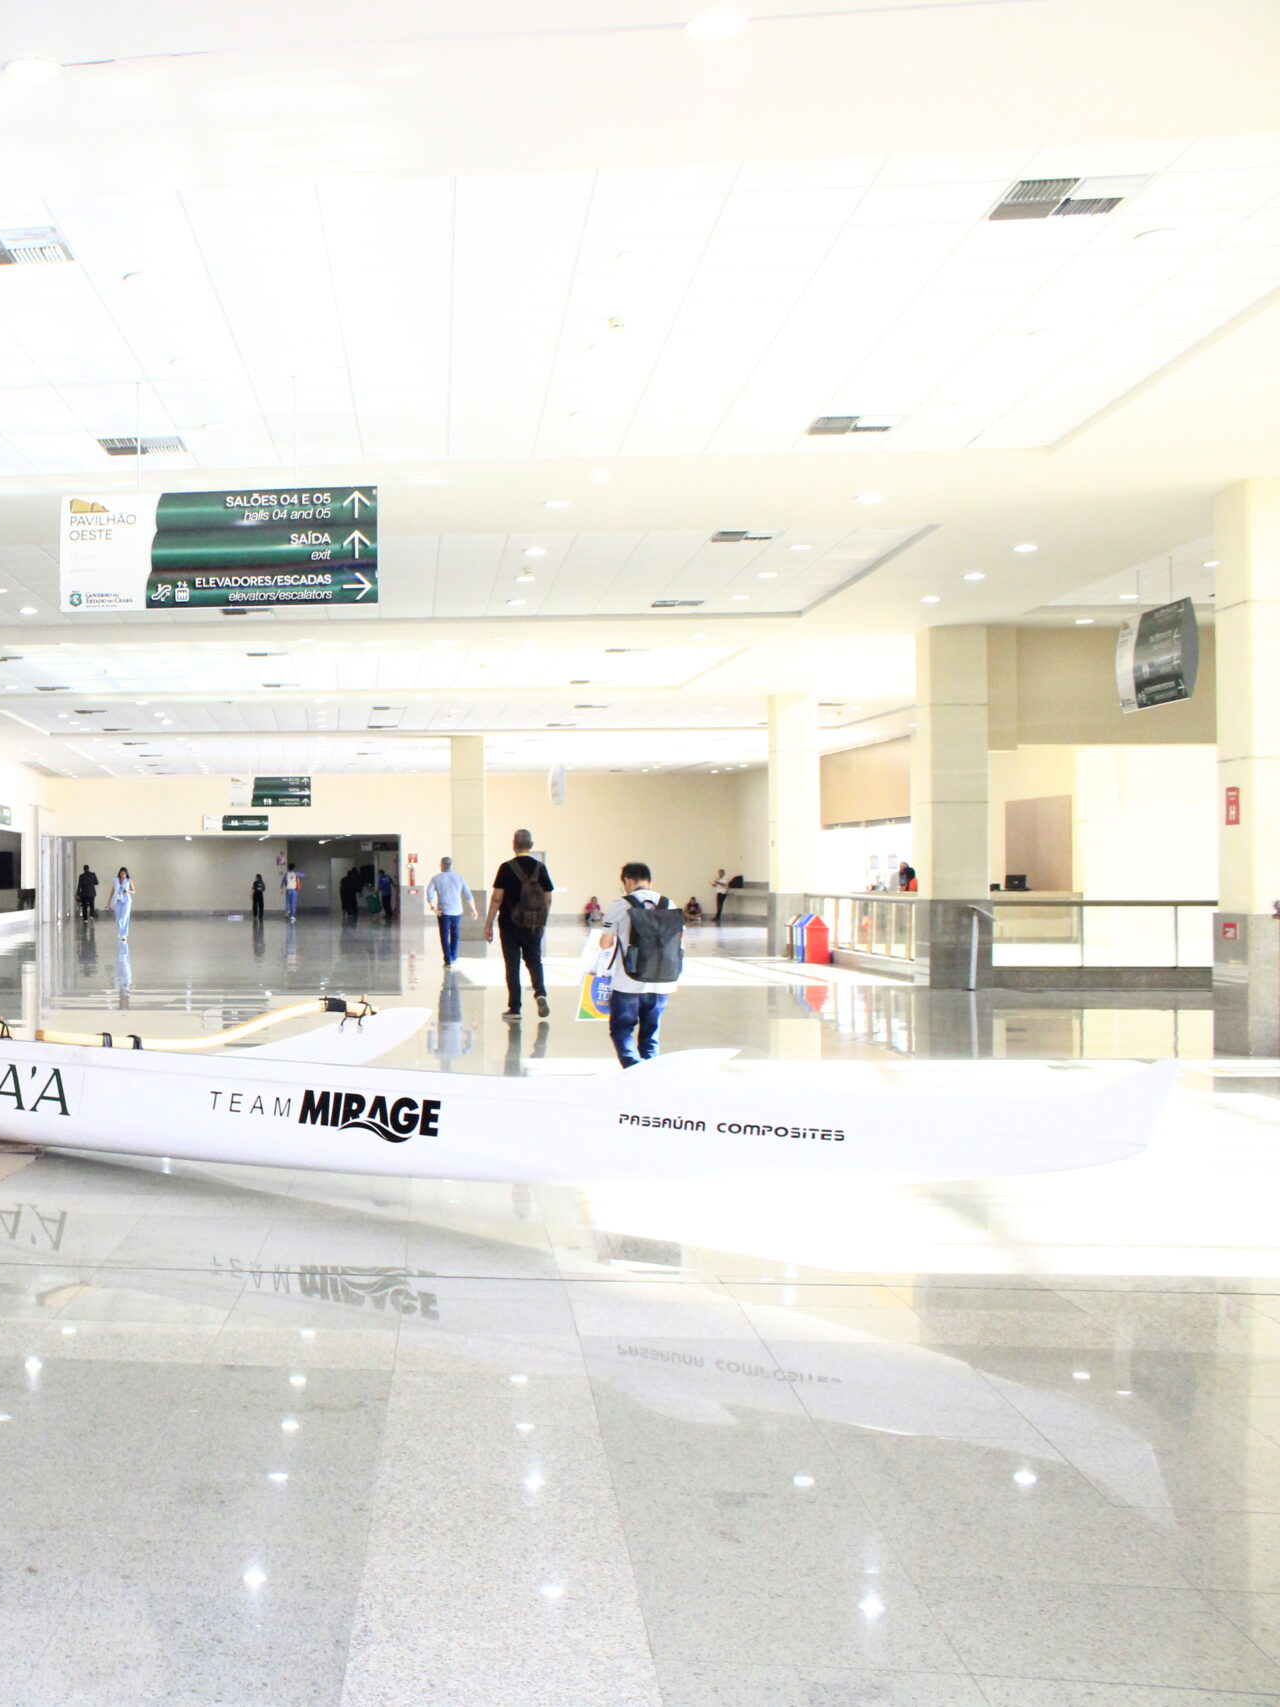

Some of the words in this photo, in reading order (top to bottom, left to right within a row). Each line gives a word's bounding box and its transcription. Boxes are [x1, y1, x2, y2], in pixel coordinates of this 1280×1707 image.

[226, 493, 277, 507] SALÕES
[280, 494, 298, 506] 04
[302, 494, 310, 504] E
[313, 493, 331, 504] 05
[70, 512, 137, 526] PAVILHÃO
[244, 510, 269, 521] halls
[272, 510, 288, 520] 04
[290, 508, 313, 520] and
[316, 508, 331, 519] 05
[69, 529, 113, 541] OESTE
[290, 530, 332, 545] SAÍDA
[311, 550, 331, 560] exit
[195, 574, 332, 588] ELEVADORES/ESCADAS
[228, 590, 332, 602] elevators/escalators
[210, 1090, 292, 1118] TEAM
[298, 1089, 442, 1141] MIRAGE
[618, 1114, 706, 1132] PASSAÚNA
